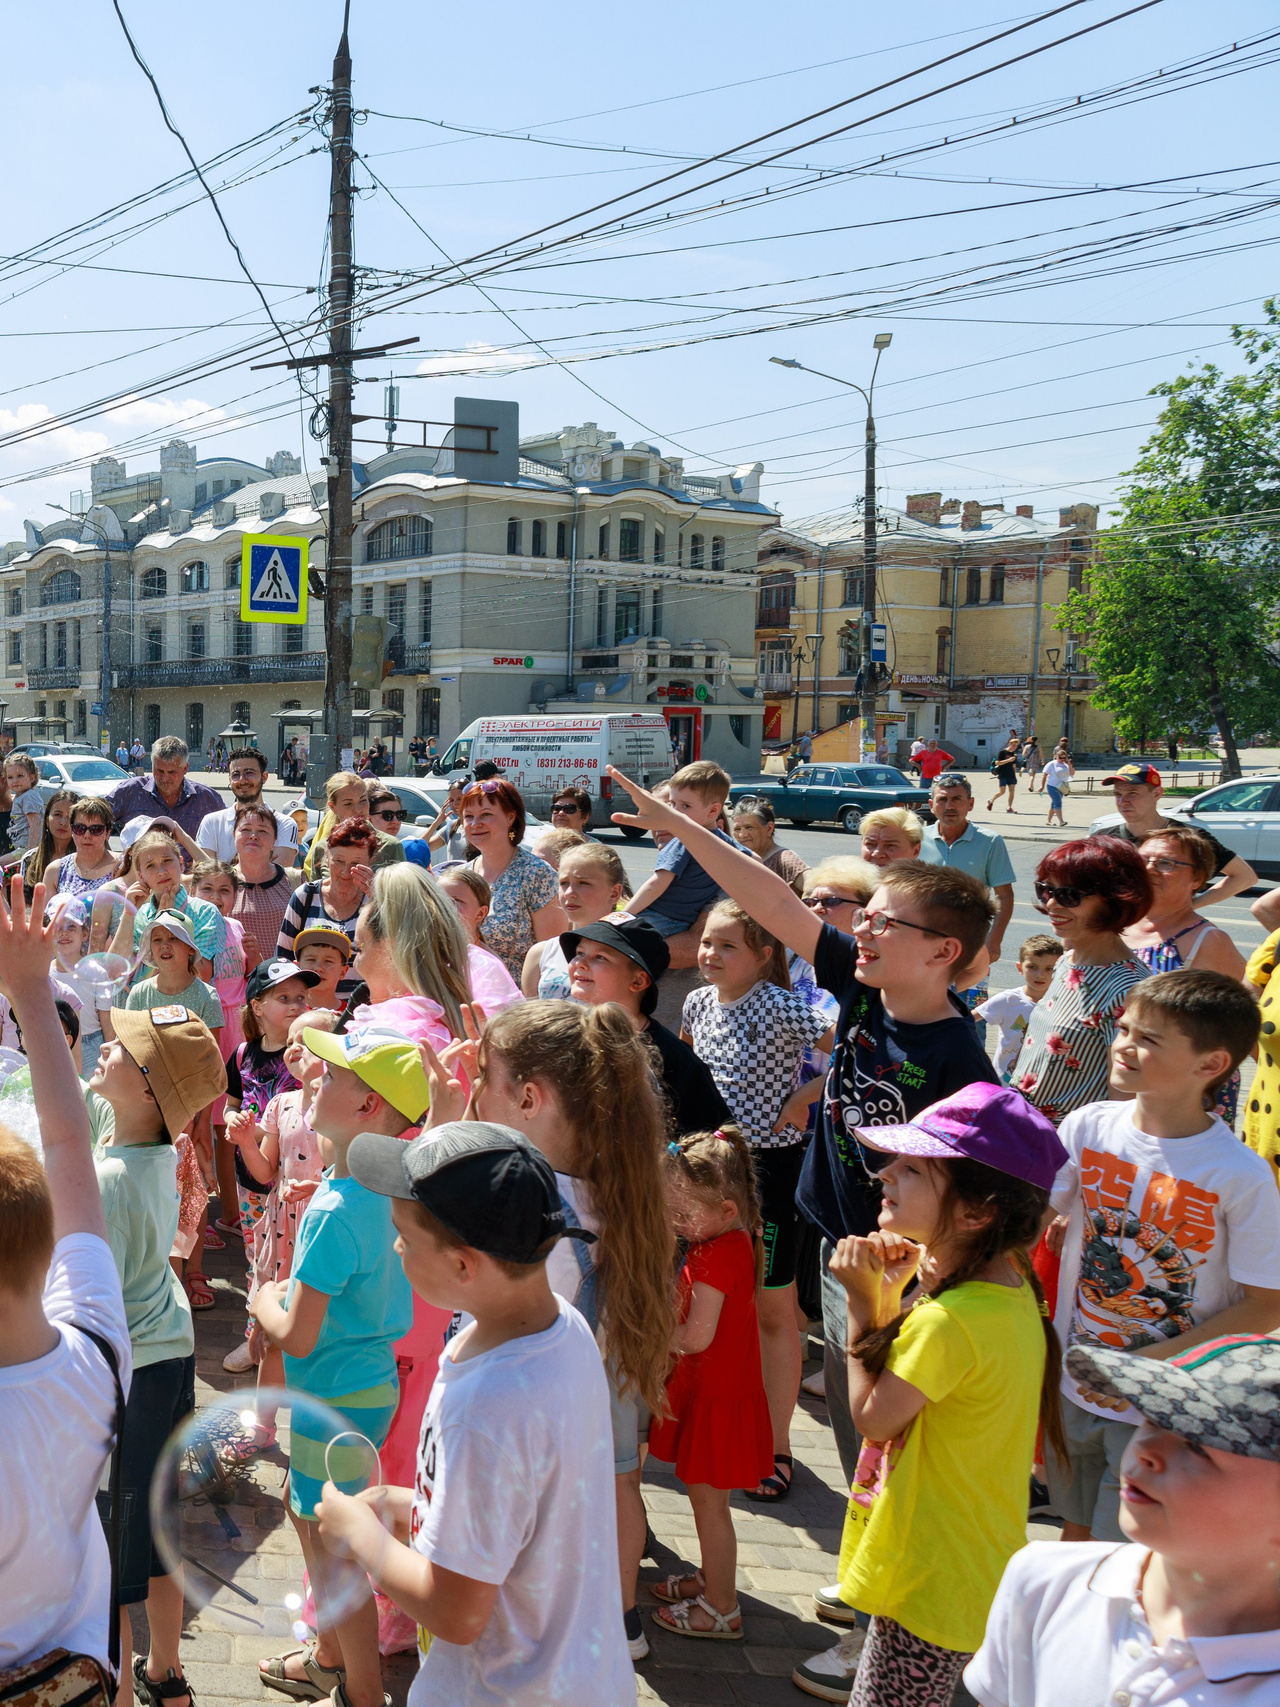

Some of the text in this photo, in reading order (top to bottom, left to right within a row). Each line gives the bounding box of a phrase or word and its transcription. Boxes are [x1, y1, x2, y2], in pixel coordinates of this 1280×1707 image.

[493, 657, 523, 665] SPAR
[657, 686, 694, 698] SPAR
[498, 719, 603, 729] ЭЛЕКТРО-СИТИ
[537, 758, 598, 769] (831) 213-86-68
[903, 1060, 927, 1078] PRESS
[896, 1072, 927, 1090] START
[763, 1221, 776, 1241] DAY
